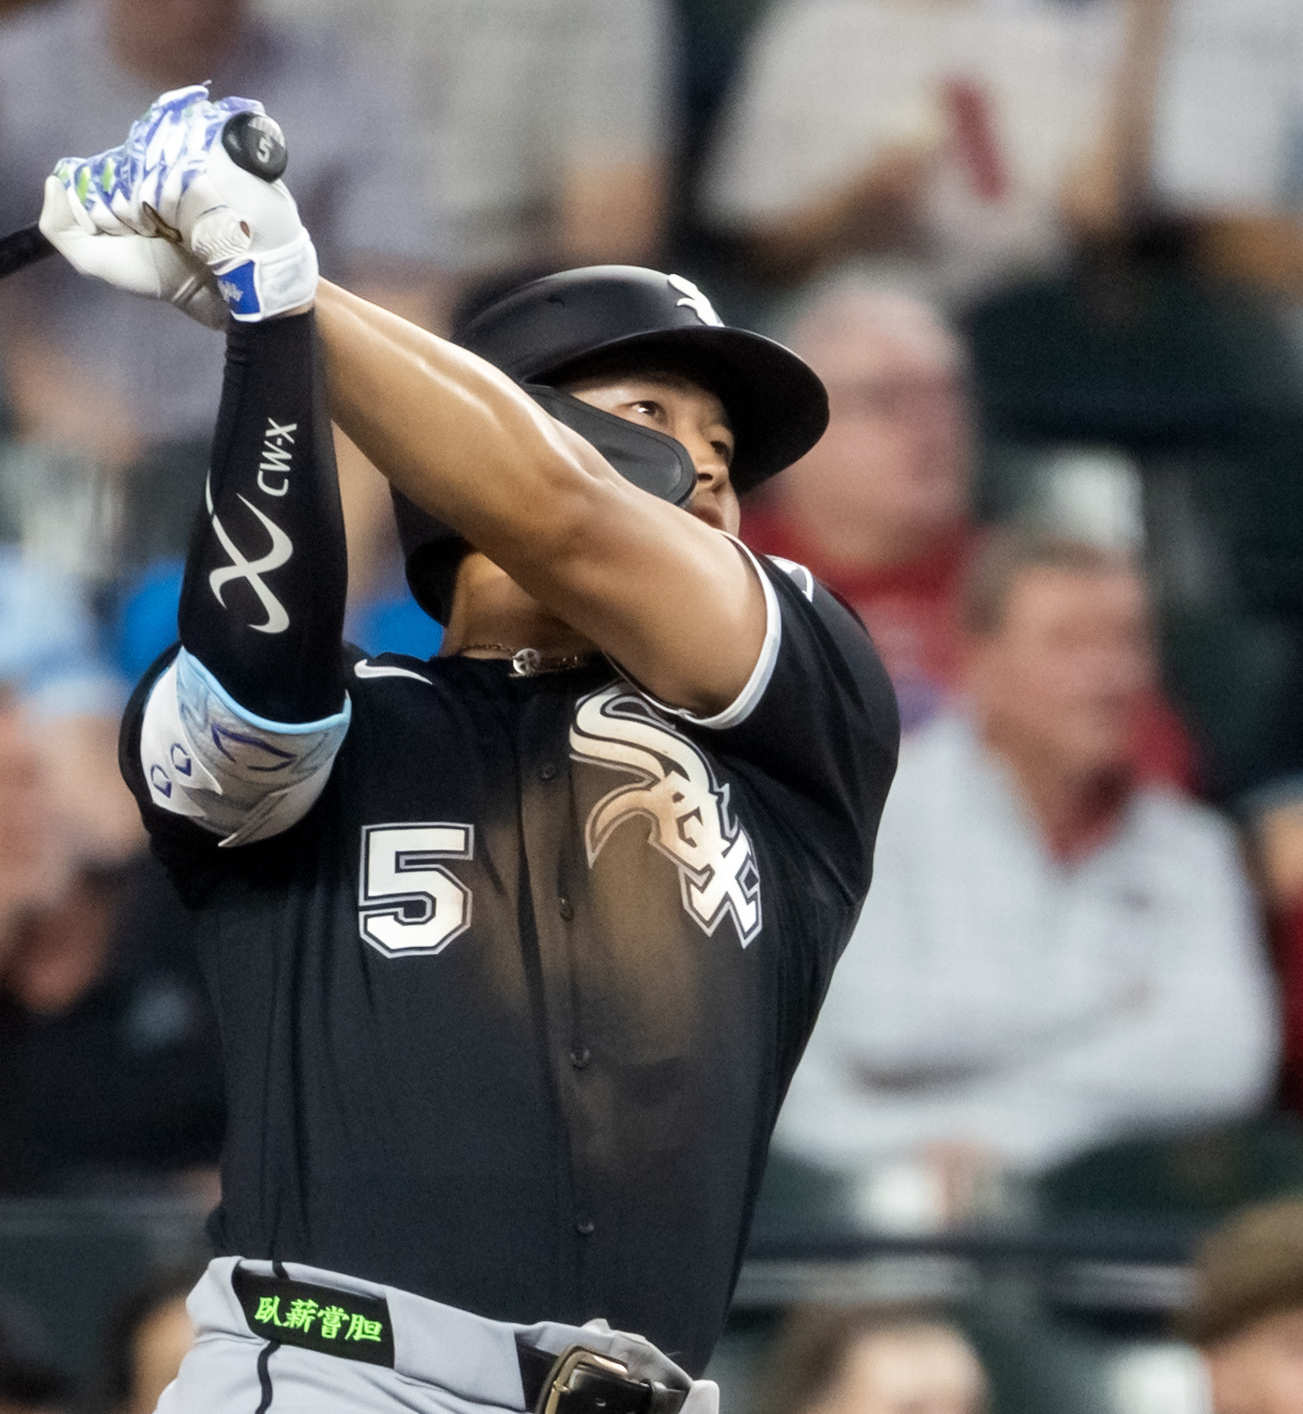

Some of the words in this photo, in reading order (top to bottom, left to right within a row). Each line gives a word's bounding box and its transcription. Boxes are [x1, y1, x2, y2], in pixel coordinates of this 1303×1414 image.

[256, 135, 273, 164] 5
[257, 417, 298, 497] CW-X
[359, 822, 474, 959] 5
